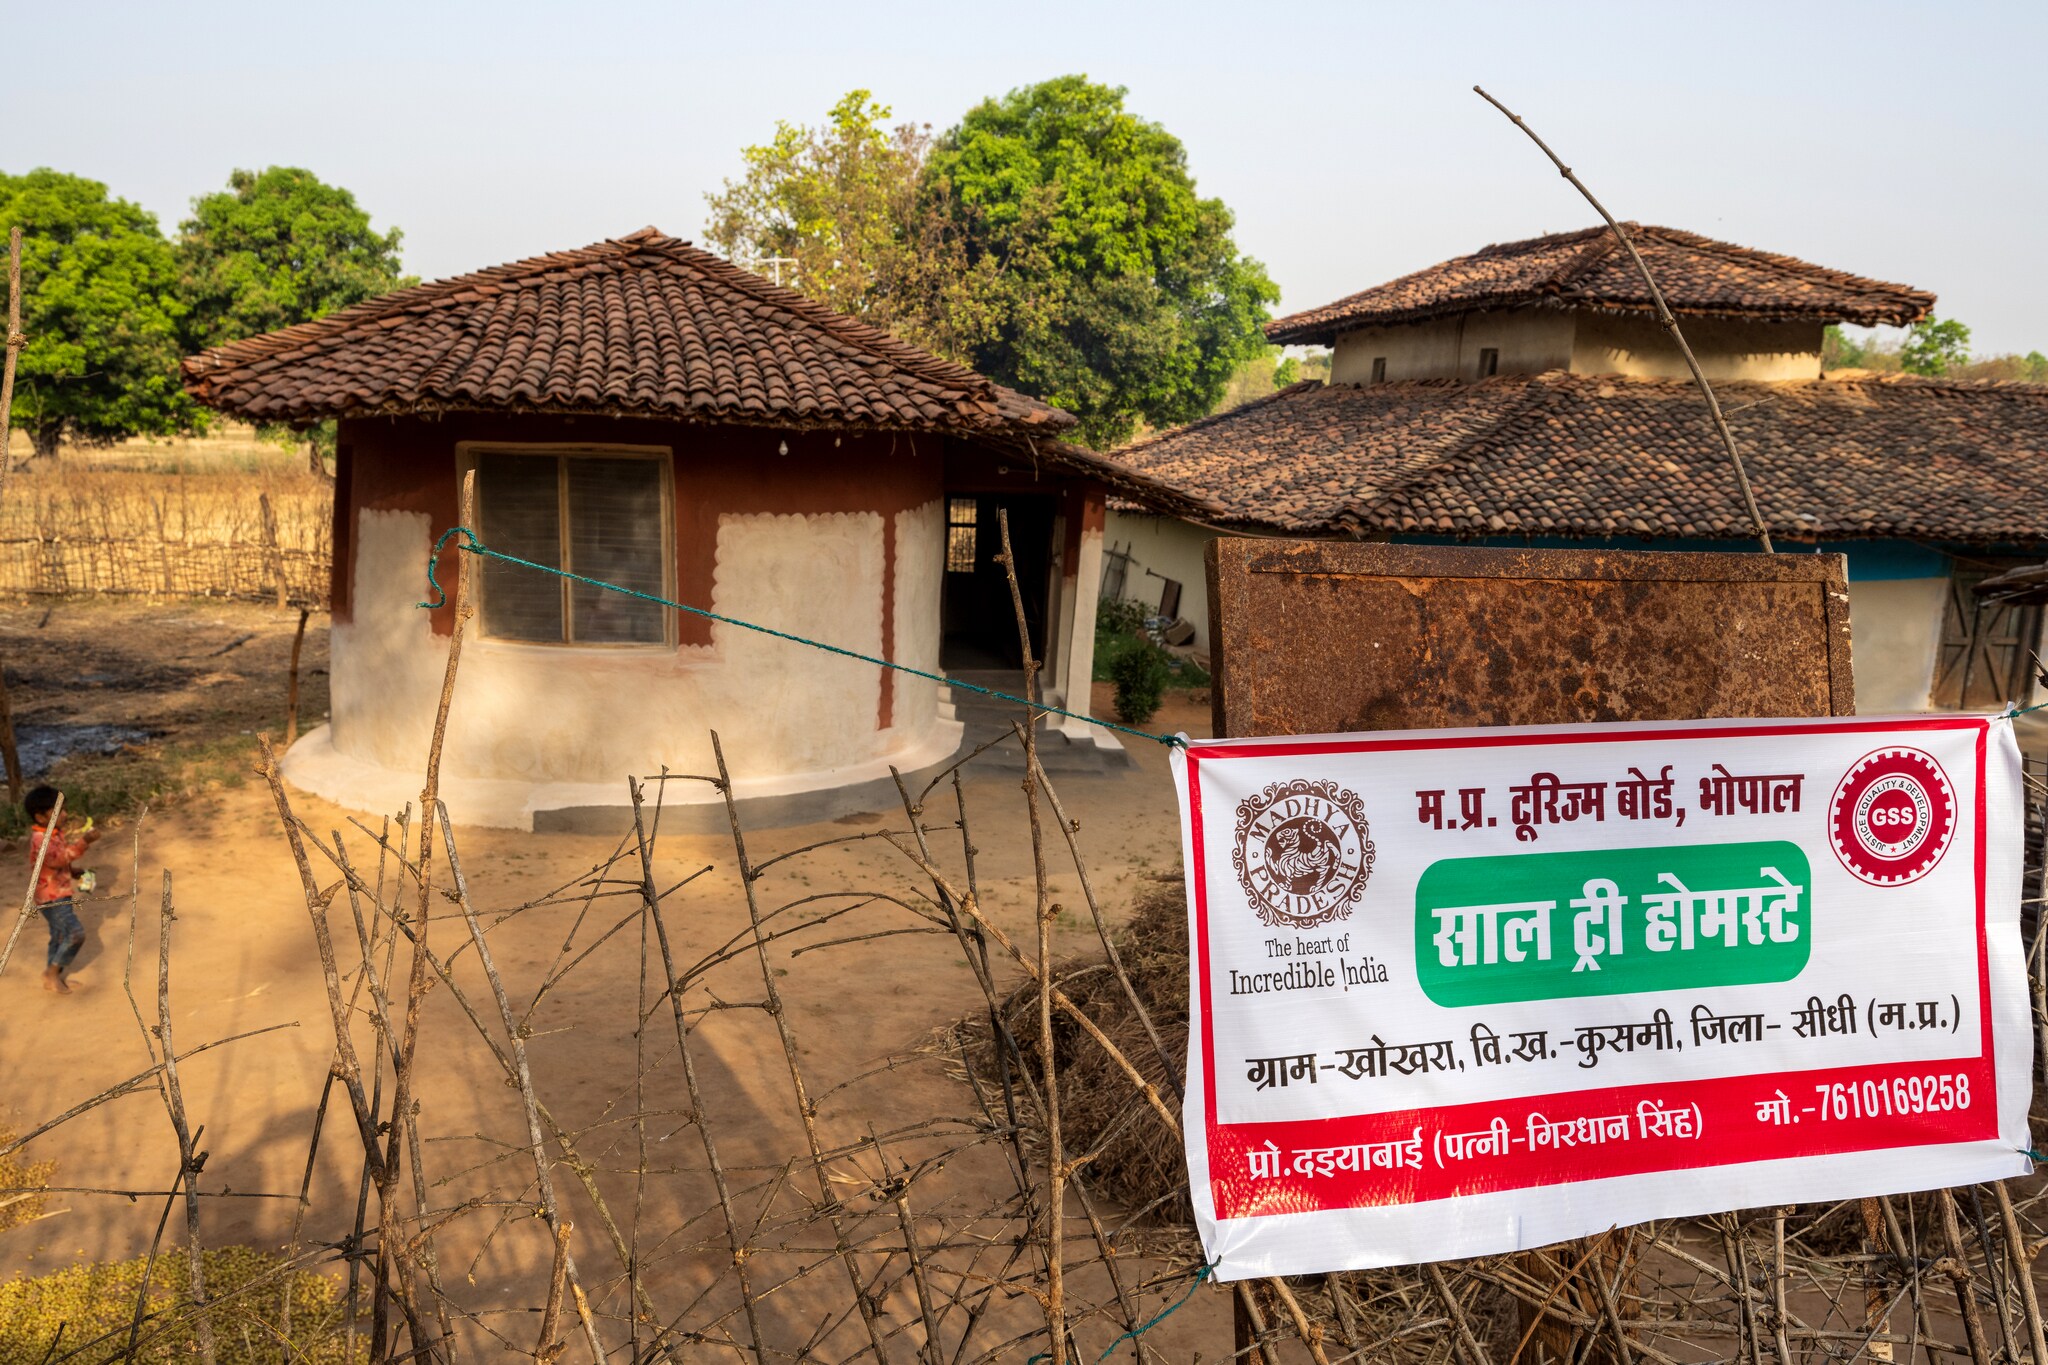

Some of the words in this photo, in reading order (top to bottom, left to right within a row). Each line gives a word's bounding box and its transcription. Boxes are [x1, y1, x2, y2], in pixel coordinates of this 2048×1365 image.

[1249, 797, 1350, 843] MADHYA
[1415, 787, 1497, 831] म.प्र.
[1509, 772, 1607, 842] टूरिज्म
[1615, 765, 1686, 828] बोर्ड,
[1699, 764, 1805, 816] भोपाल
[1871, 807, 1914, 826] GSS
[1858, 819, 1887, 851] JUSTICE
[1251, 862, 1358, 914] PRADESH
[1431, 900, 1557, 967] साल
[1569, 878, 1628, 973] ट्री
[1641, 866, 1804, 953] होमस्टे
[1265, 937, 1292, 957] The
[1296, 936, 1333, 955] heart
[1336, 933, 1350, 952] of
[1229, 961, 1335, 995] Incredible
[1791, 993, 1857, 1039] सीधी
[1867, 994, 1961, 1039] (म.प्र.)
[1637, 1099, 1702, 1140] सिंह)
